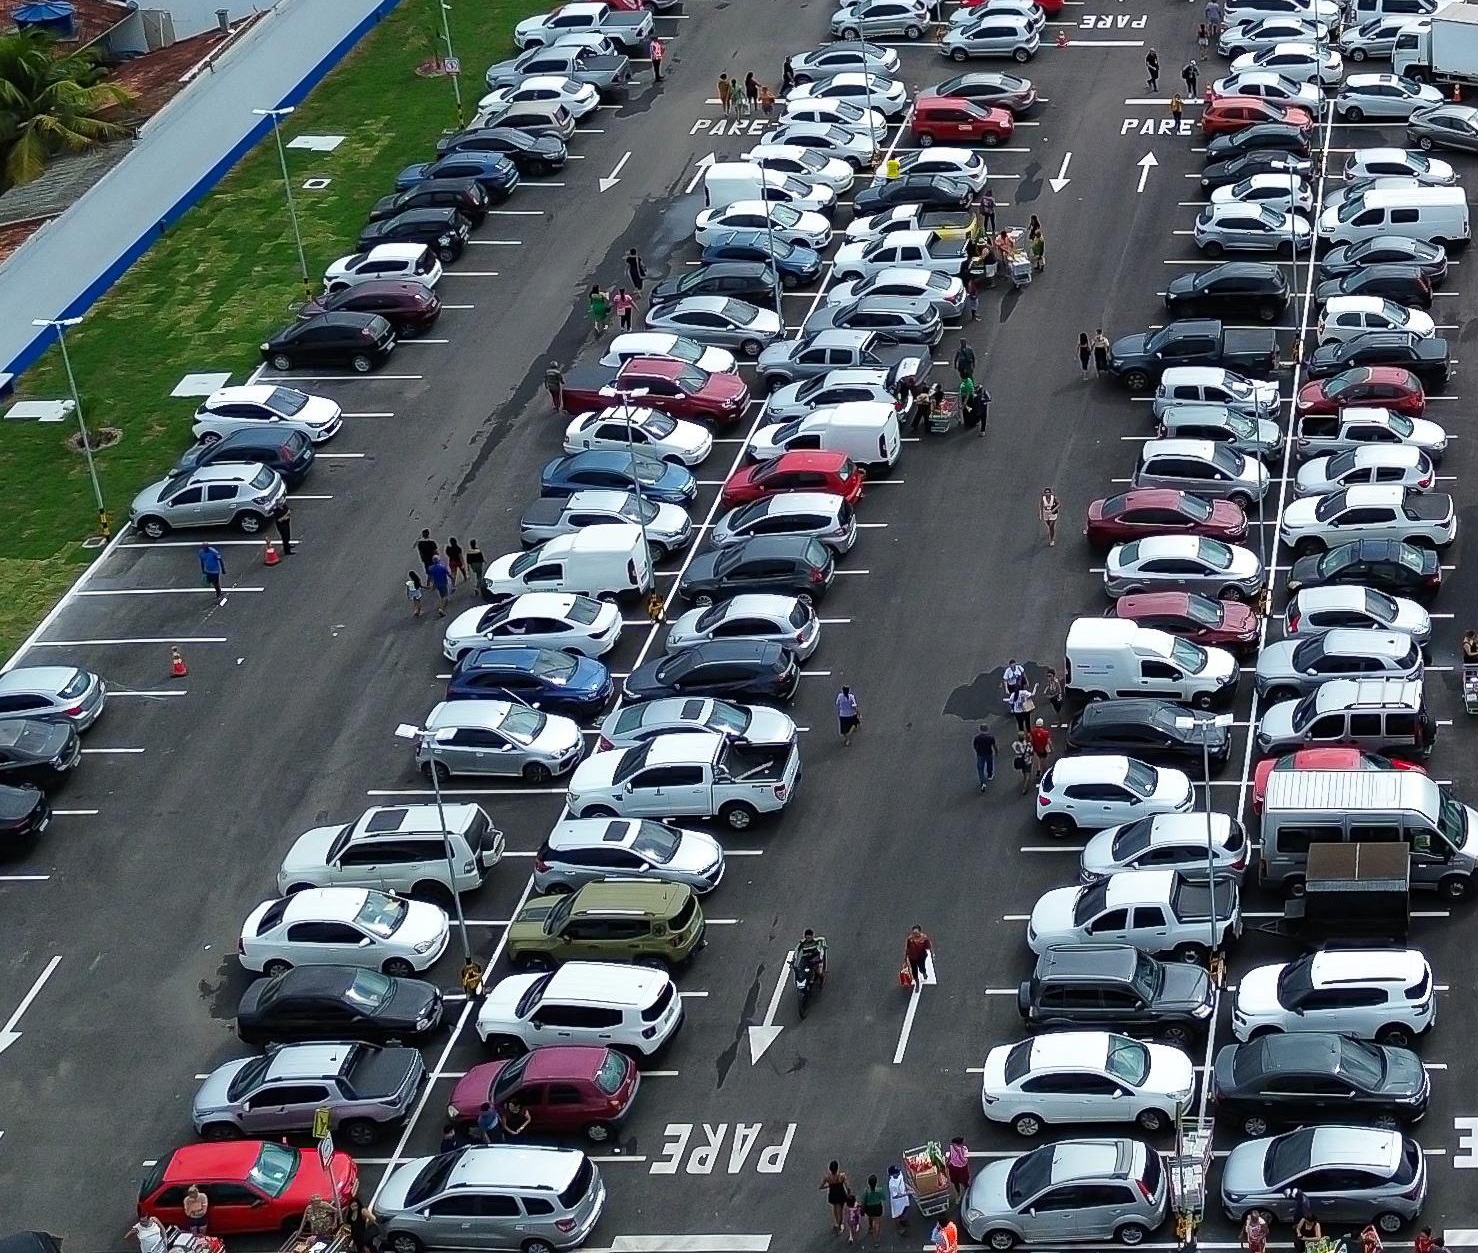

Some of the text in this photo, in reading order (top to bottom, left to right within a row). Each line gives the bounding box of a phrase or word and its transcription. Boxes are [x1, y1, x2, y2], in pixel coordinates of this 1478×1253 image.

[1079, 14, 1148, 29] PARE
[689, 119, 770, 136] PARE
[1120, 118, 1195, 135] PARE
[649, 1122, 798, 1175] PARE
